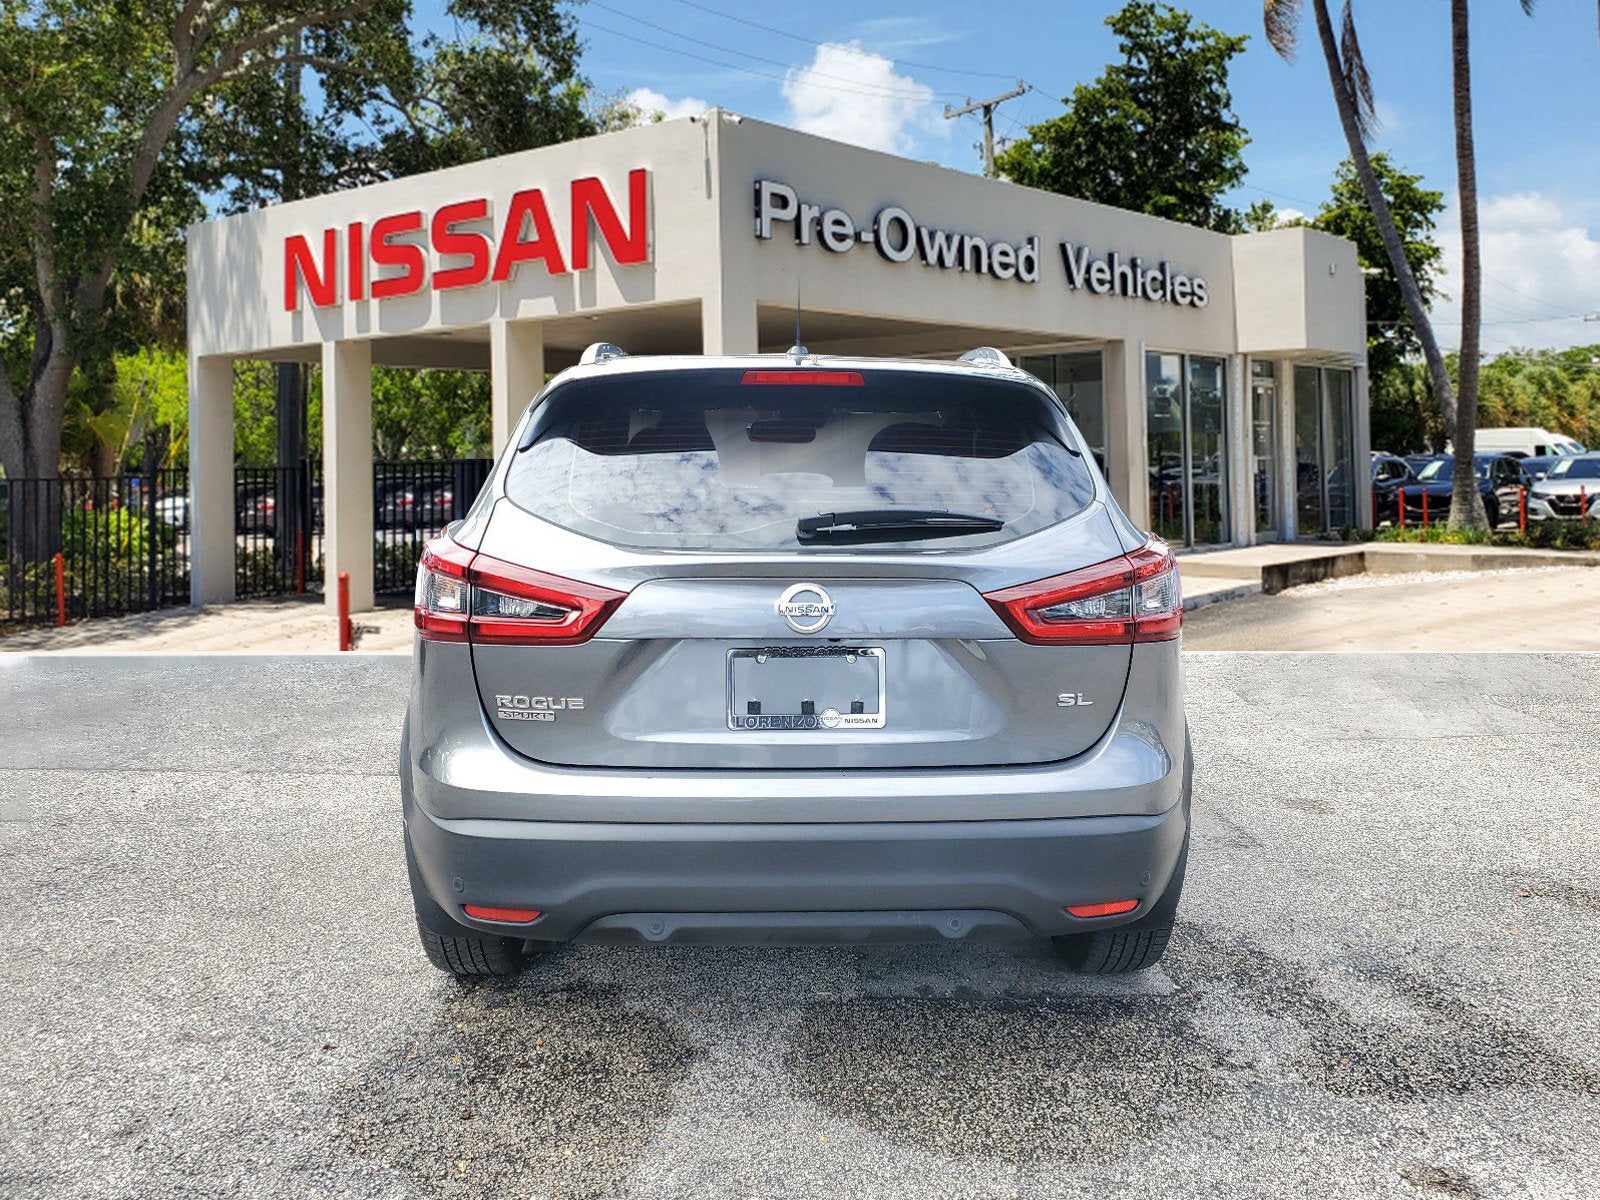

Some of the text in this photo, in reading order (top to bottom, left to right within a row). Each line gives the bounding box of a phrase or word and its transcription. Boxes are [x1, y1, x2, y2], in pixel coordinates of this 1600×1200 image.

[284, 168, 648, 312] NISSAN
[754, 180, 1209, 308] Pre-Owned Vehicles
[785, 605, 829, 614] NISSAN
[495, 695, 585, 709] ROGUE
[1057, 693, 1094, 707] SL
[504, 711, 549, 719] SPORT
[735, 715, 819, 729] LORENZO
